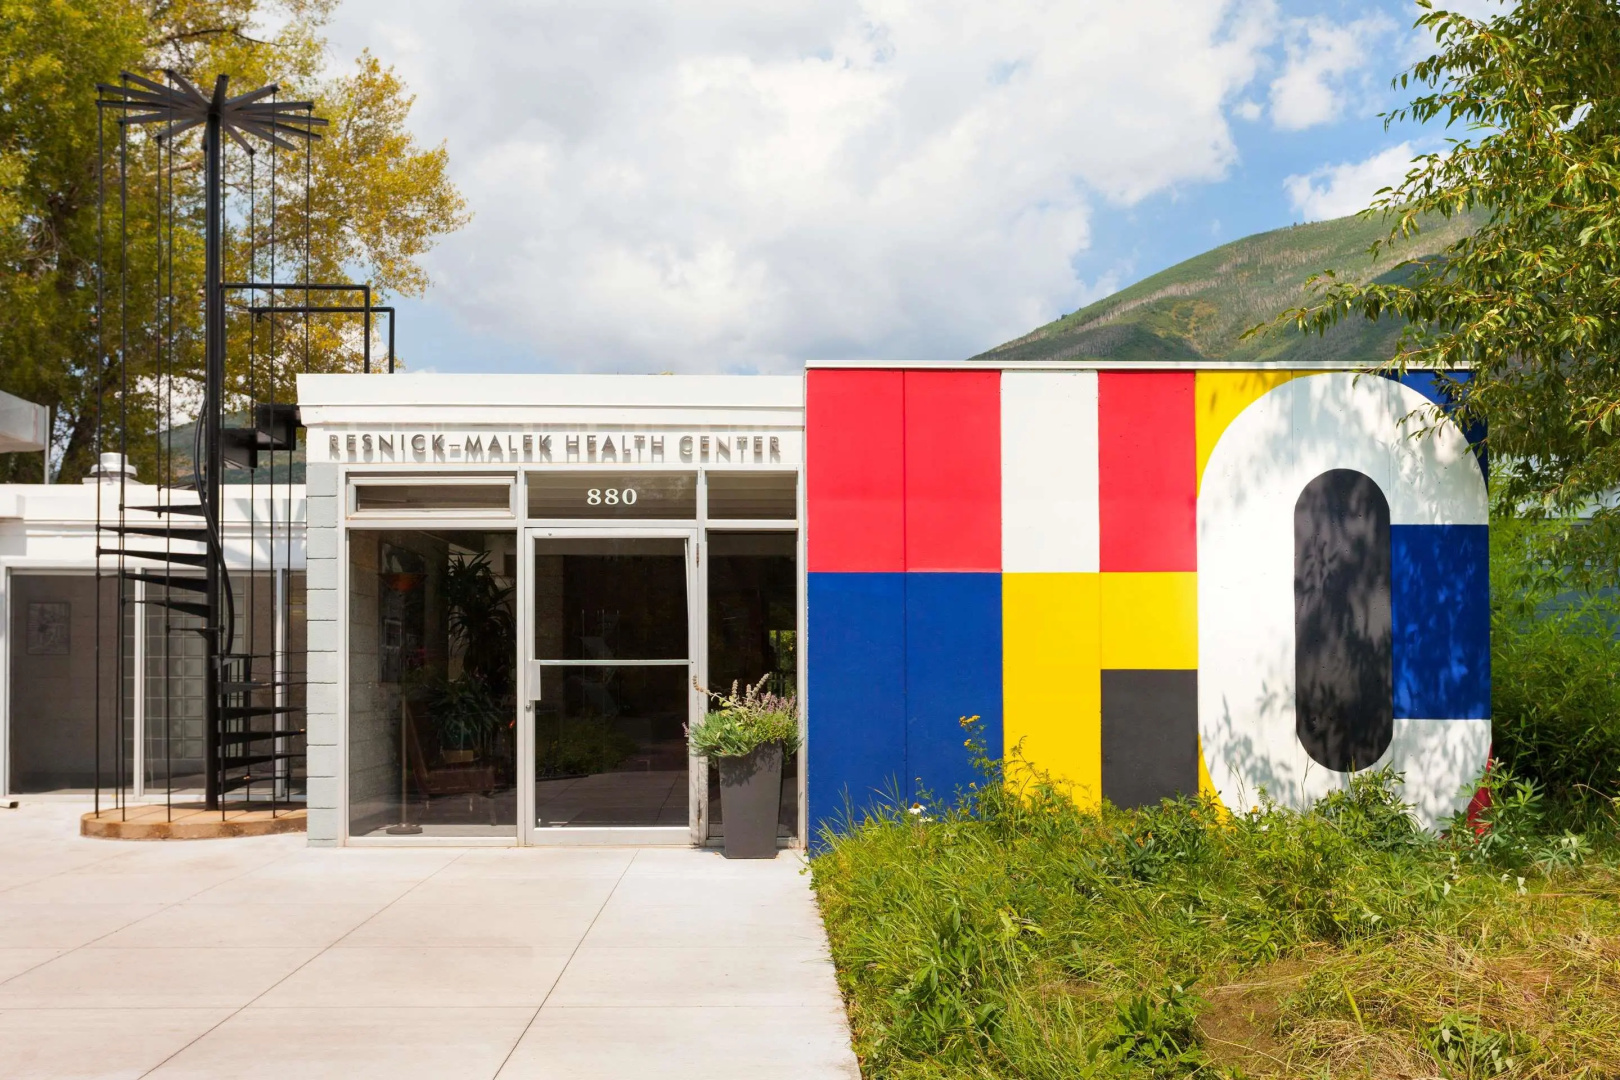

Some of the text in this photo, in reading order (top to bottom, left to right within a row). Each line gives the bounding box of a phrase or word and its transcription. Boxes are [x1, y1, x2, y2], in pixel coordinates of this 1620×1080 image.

[329, 434, 780, 454] RESNICK-MALEK HEALTH CENTER
[586, 488, 637, 505] 880
